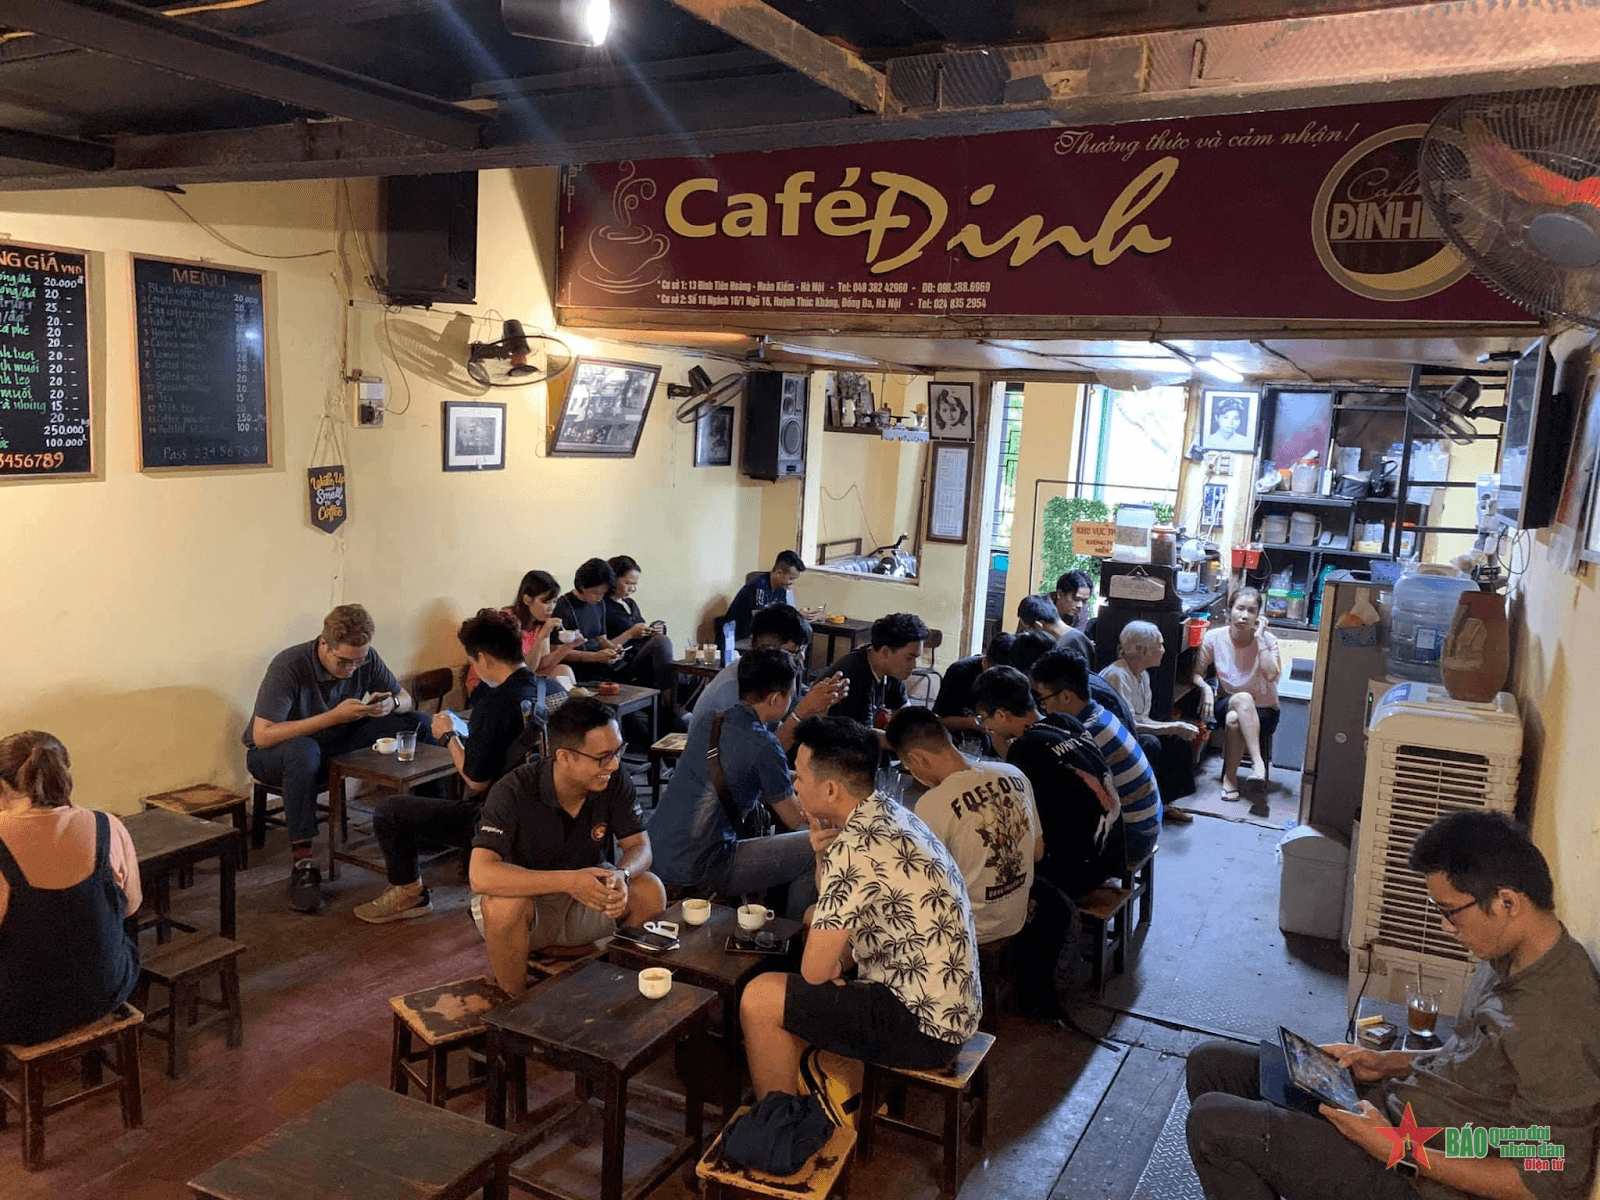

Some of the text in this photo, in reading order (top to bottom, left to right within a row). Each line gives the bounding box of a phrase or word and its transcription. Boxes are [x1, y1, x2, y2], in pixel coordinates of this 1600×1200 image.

[1054, 130, 1141, 161] Thưởng
[1146, 129, 1190, 150] thức
[1195, 130, 1222, 148] và
[1228, 127, 1275, 147] cảm
[663, 157, 1172, 274] Café Đinh
[689, 280, 697, 290] 13
[46, 327, 61, 337] 20
